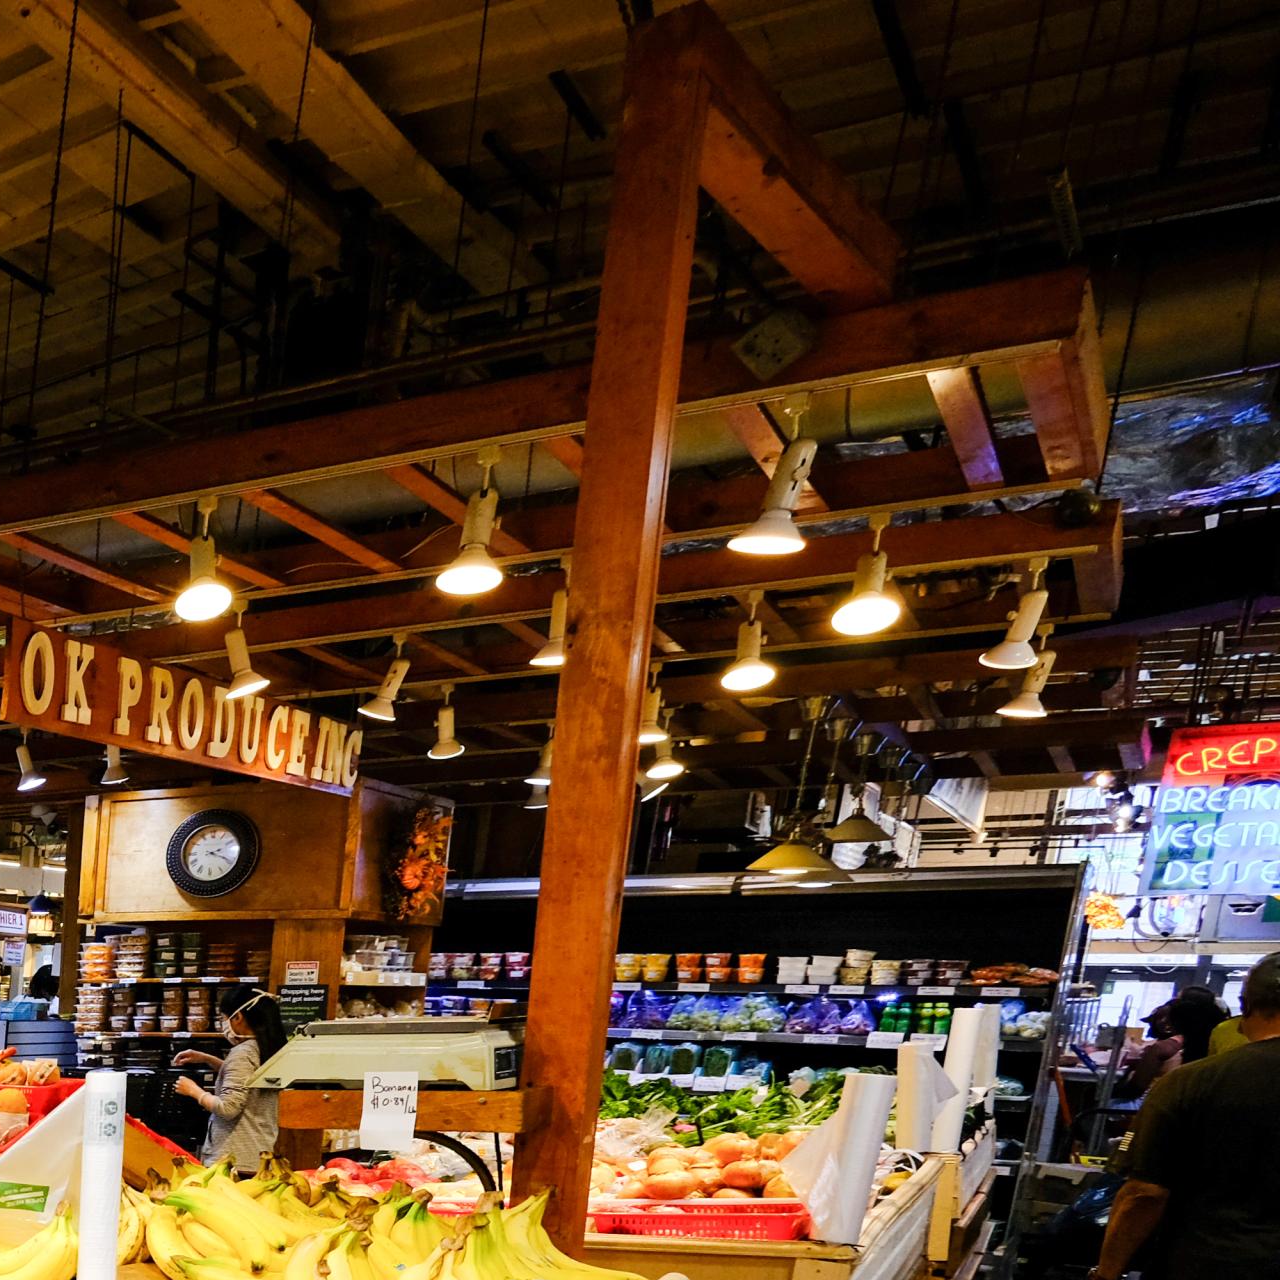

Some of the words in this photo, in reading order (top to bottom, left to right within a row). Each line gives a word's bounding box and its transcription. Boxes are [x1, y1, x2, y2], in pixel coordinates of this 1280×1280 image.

[21, 631, 95, 726] OK
[113, 657, 309, 776] PRODUCE
[310, 716, 364, 787] INC
[1151, 821, 1280, 849] VEGETA
[19, 915, 24, 926] 1
